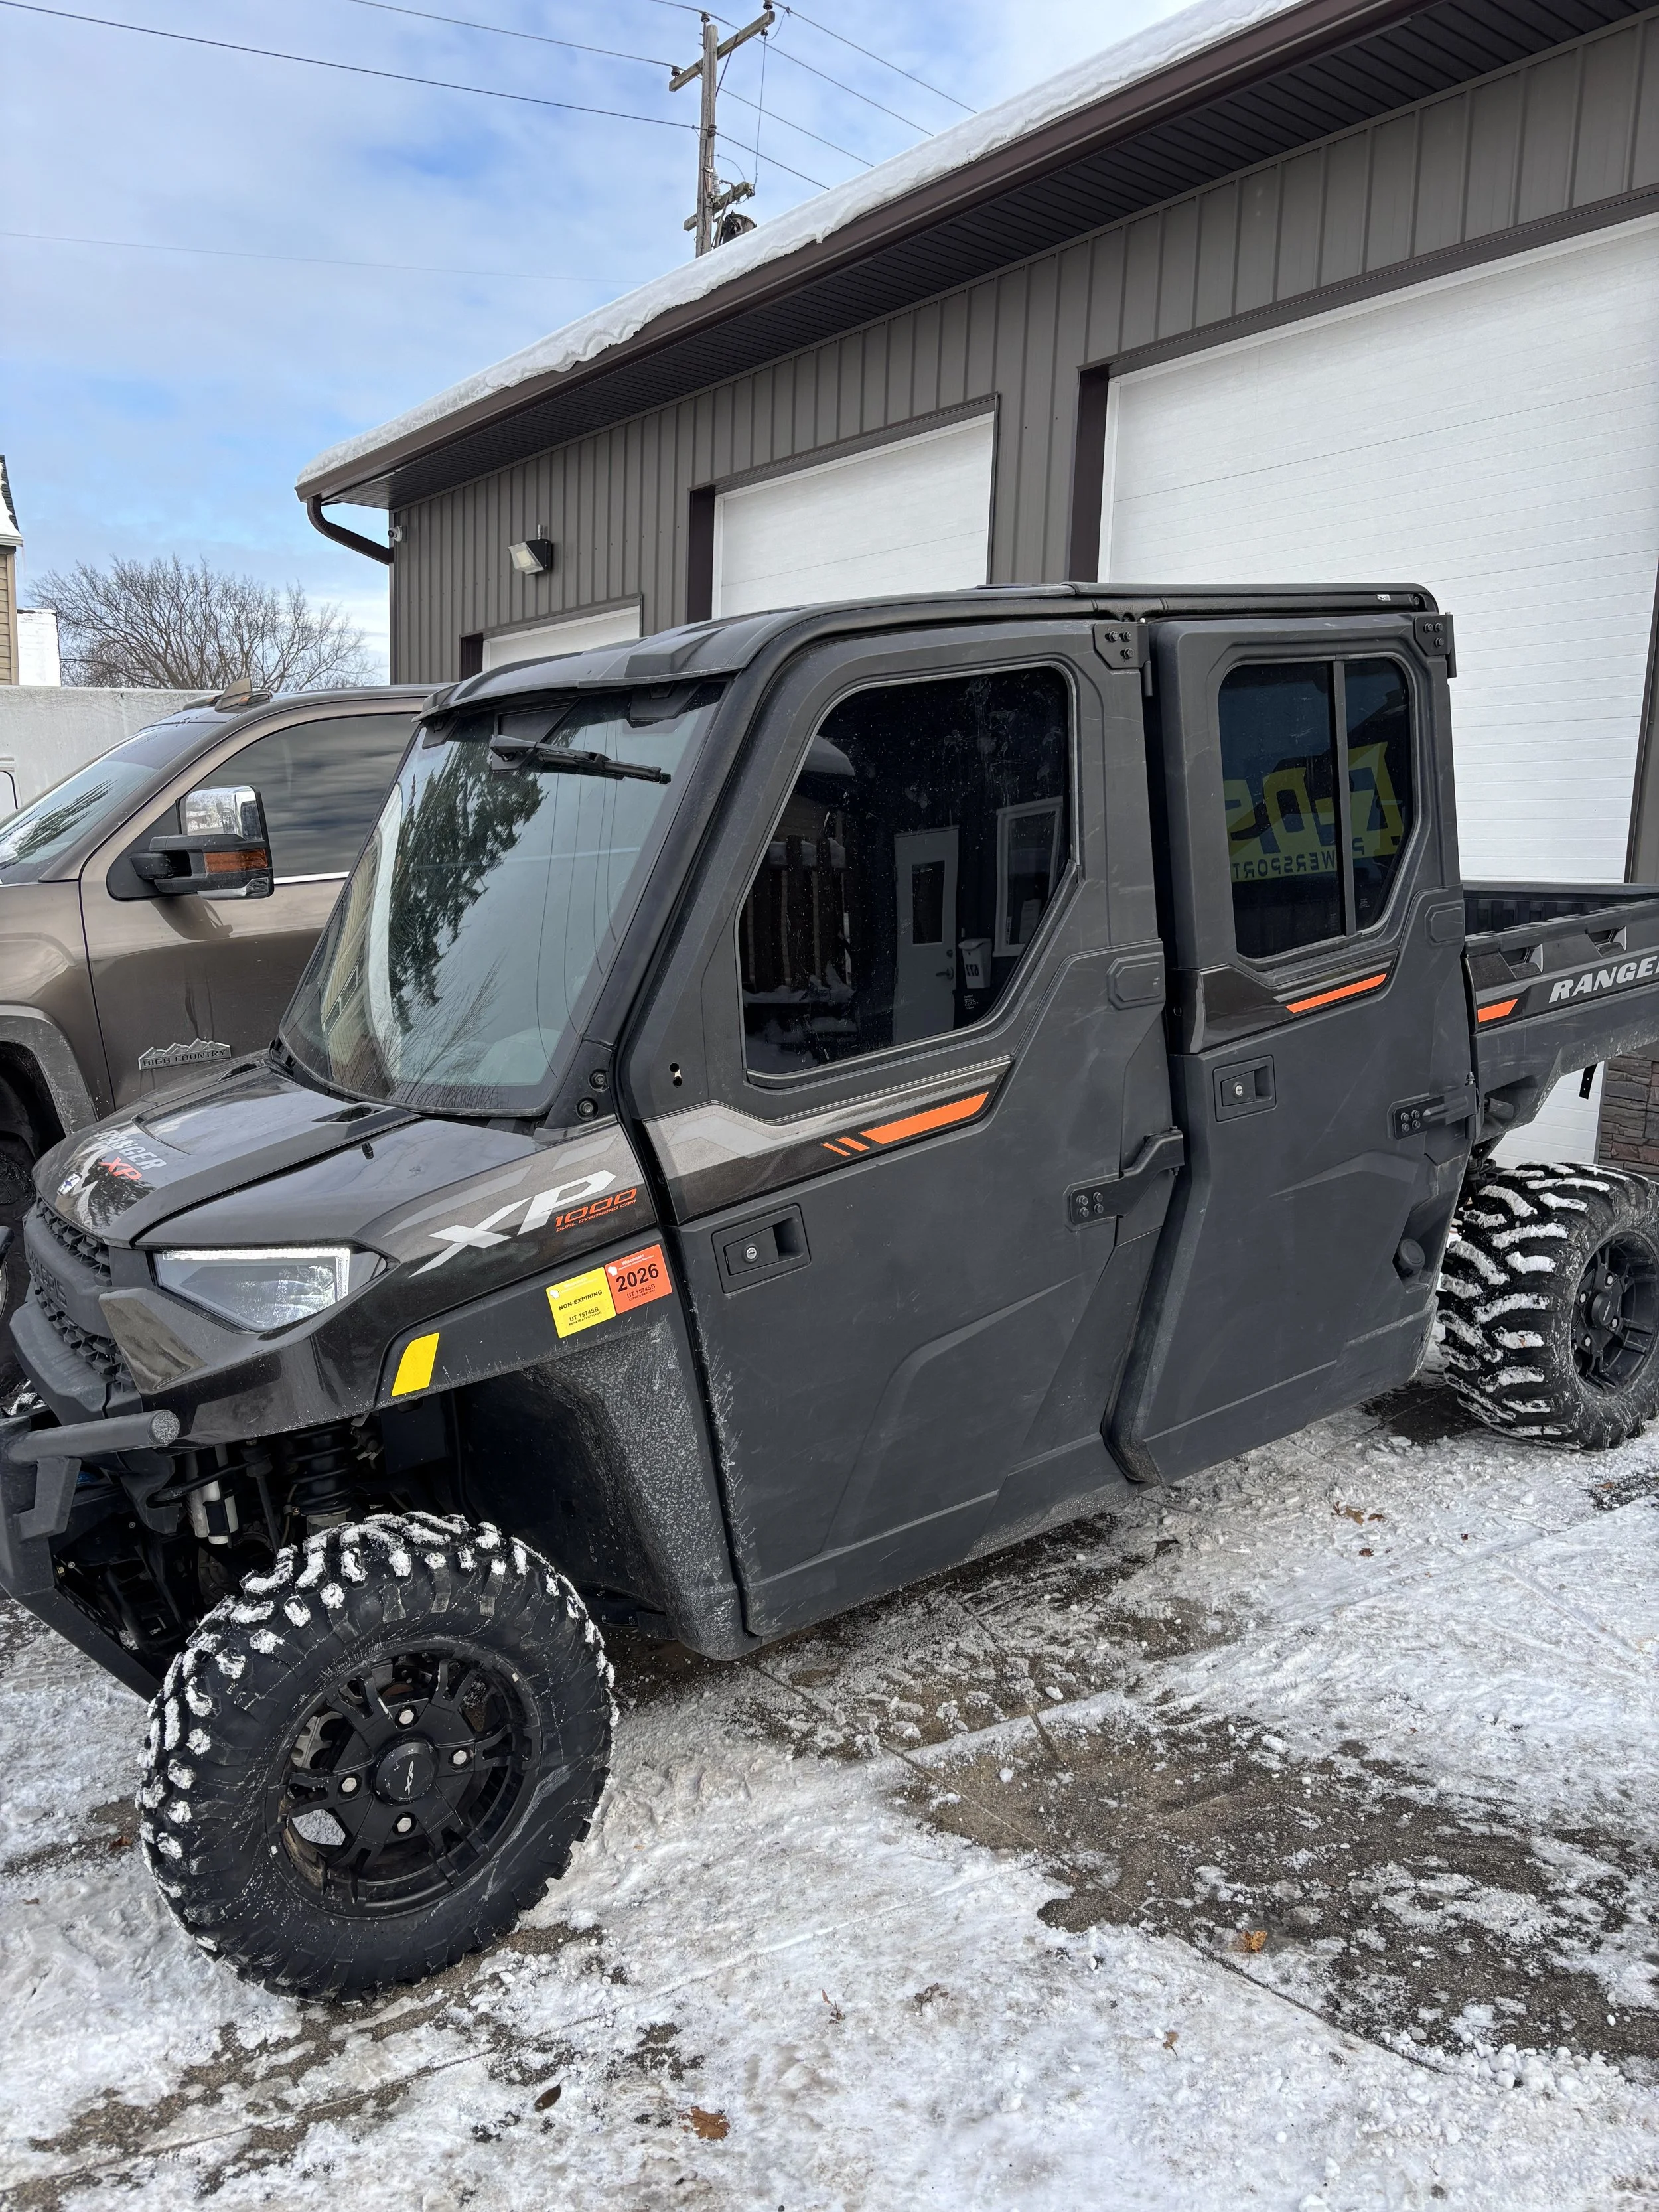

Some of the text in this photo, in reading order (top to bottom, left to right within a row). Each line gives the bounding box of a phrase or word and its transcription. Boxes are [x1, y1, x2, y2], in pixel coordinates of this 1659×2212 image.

[1548, 955, 1659, 1003] RANGE
[143, 1049, 226, 1067] HIGH COUNTRY
[93, 1130, 167, 1171] RANGER
[98, 1157, 143, 1180] XP
[555, 1187, 637, 1227] 1000
[556, 1199, 637, 1232] DUAL OVERHEAD CAM
[407, 1169, 617, 1279] XP
[616, 1263, 659, 1292] 2026
[636, 1284, 656, 1295] 1574SB
[558, 1290, 603, 1311] NON-EXPIRING
[579, 1307, 599, 1318] 1574SB
[404, 1761, 414, 1795] XP
